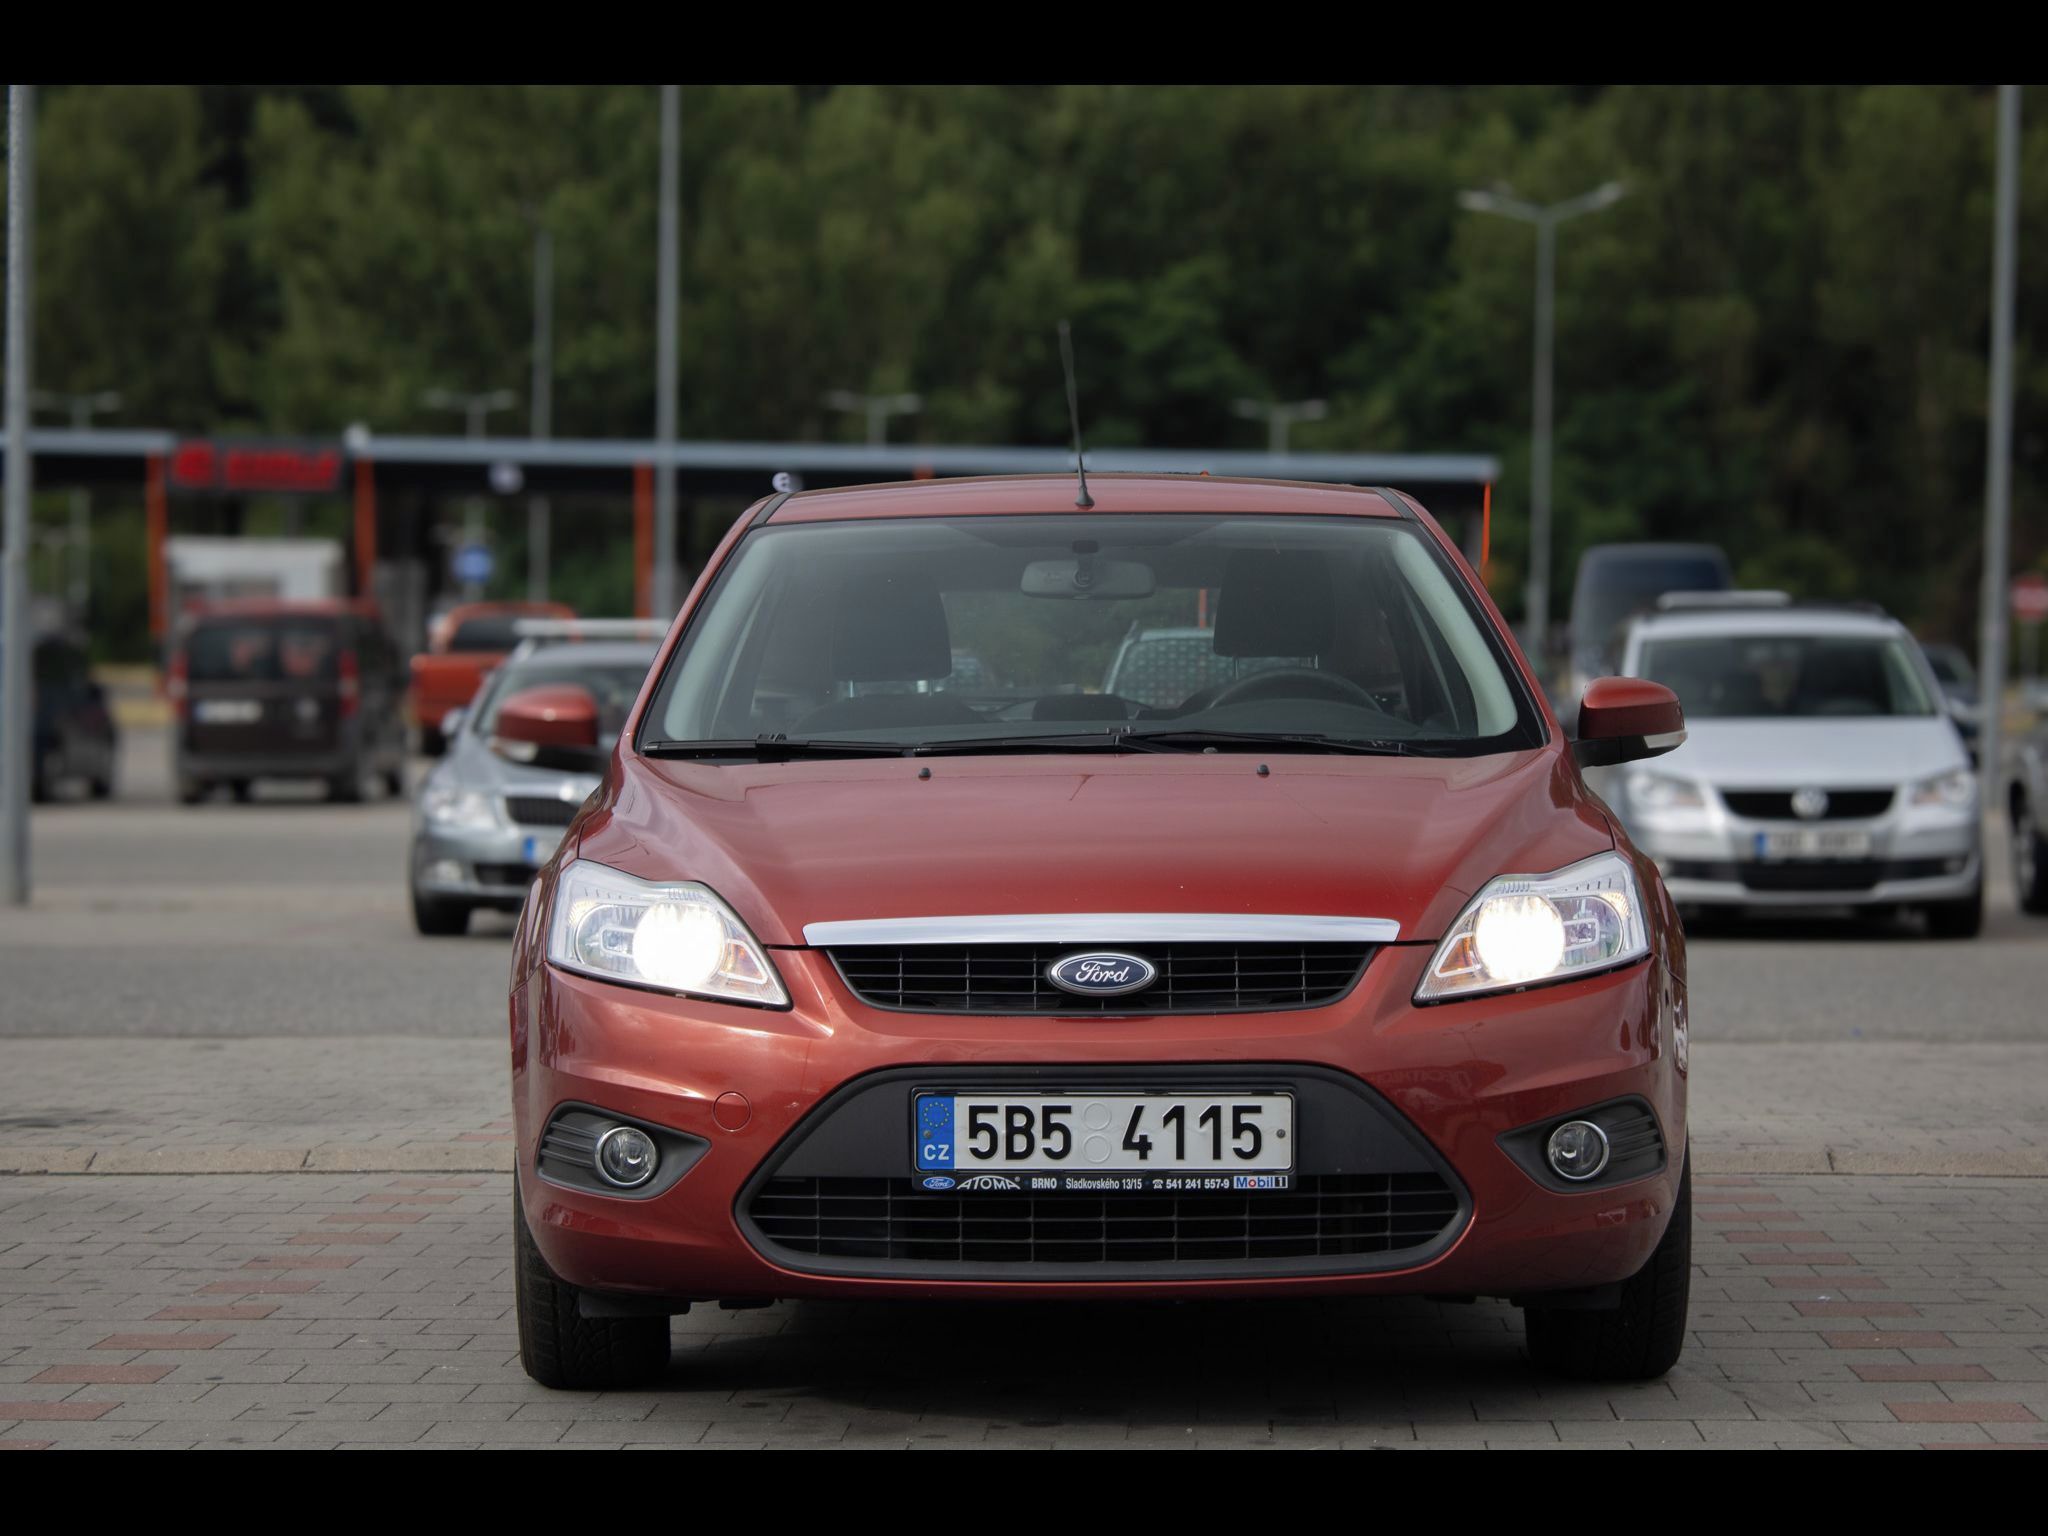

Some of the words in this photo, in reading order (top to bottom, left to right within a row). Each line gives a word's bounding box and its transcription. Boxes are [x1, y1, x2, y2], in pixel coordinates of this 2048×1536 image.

[1075, 960, 1130, 982] Ford
[968, 1104, 1072, 1160] 5B5
[1122, 1104, 1263, 1160] 4115
[923, 1144, 950, 1161] CZ
[1031, 1177, 1057, 1189] BRNO
[1065, 1177, 1120, 1190] Sladkovského
[1166, 1178, 1182, 1189] 541
[1185, 1178, 1201, 1189] 241
[1235, 1176, 1274, 1189] Mobil
